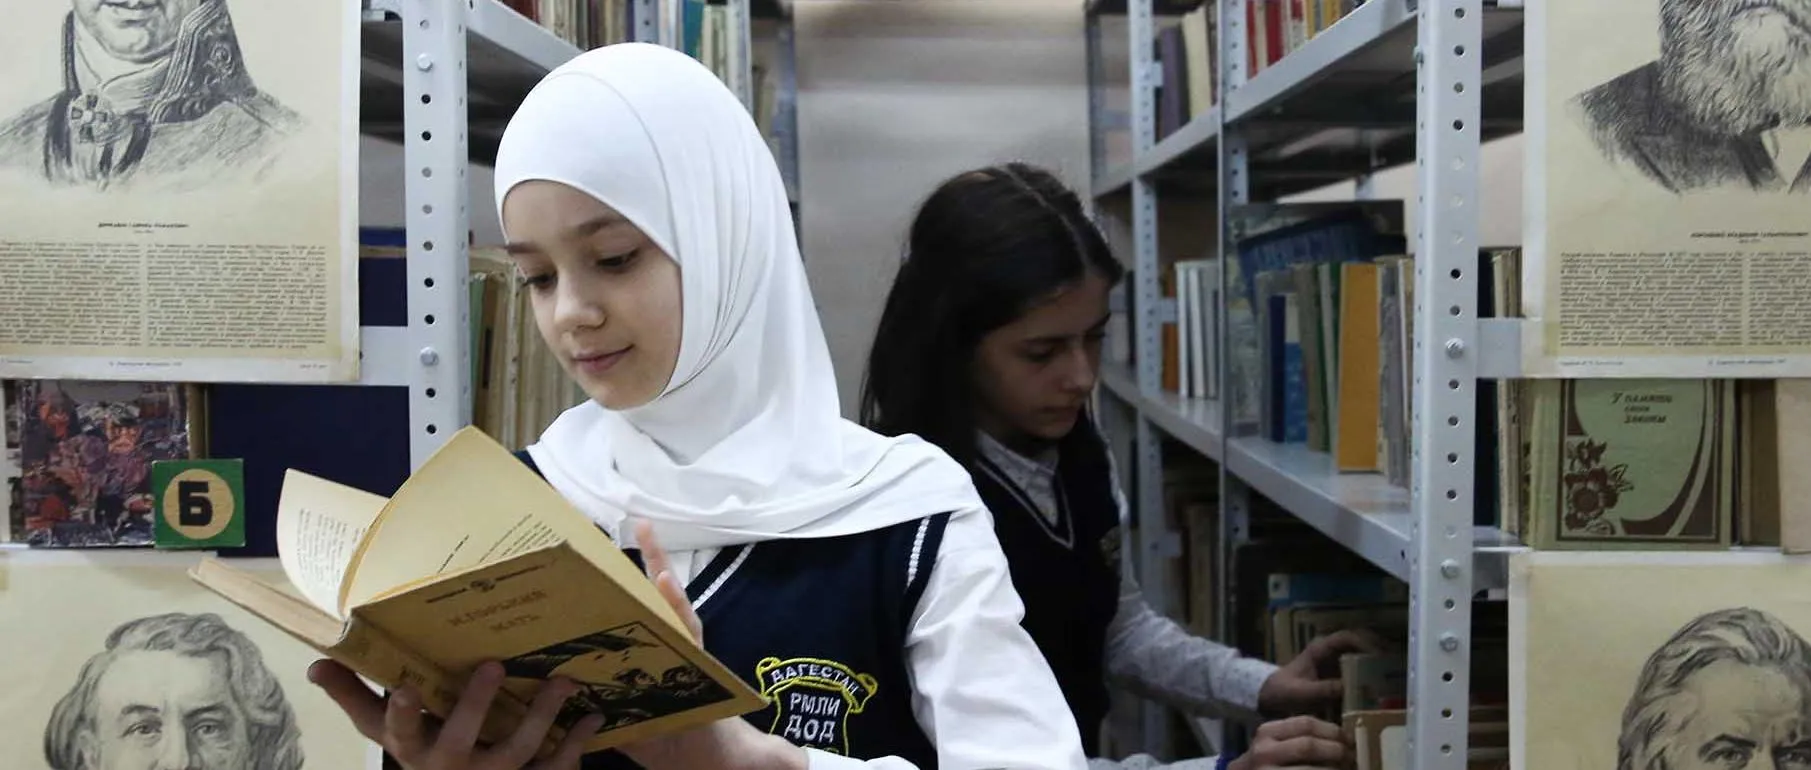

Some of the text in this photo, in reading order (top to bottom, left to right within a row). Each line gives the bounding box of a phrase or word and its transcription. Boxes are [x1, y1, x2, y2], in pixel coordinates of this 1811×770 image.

[178, 481, 213, 526] Б
[770, 663, 860, 696] ДАГЕСТАН
[790, 692, 841, 717] РМЛИ
[784, 714, 836, 743] ДОД
